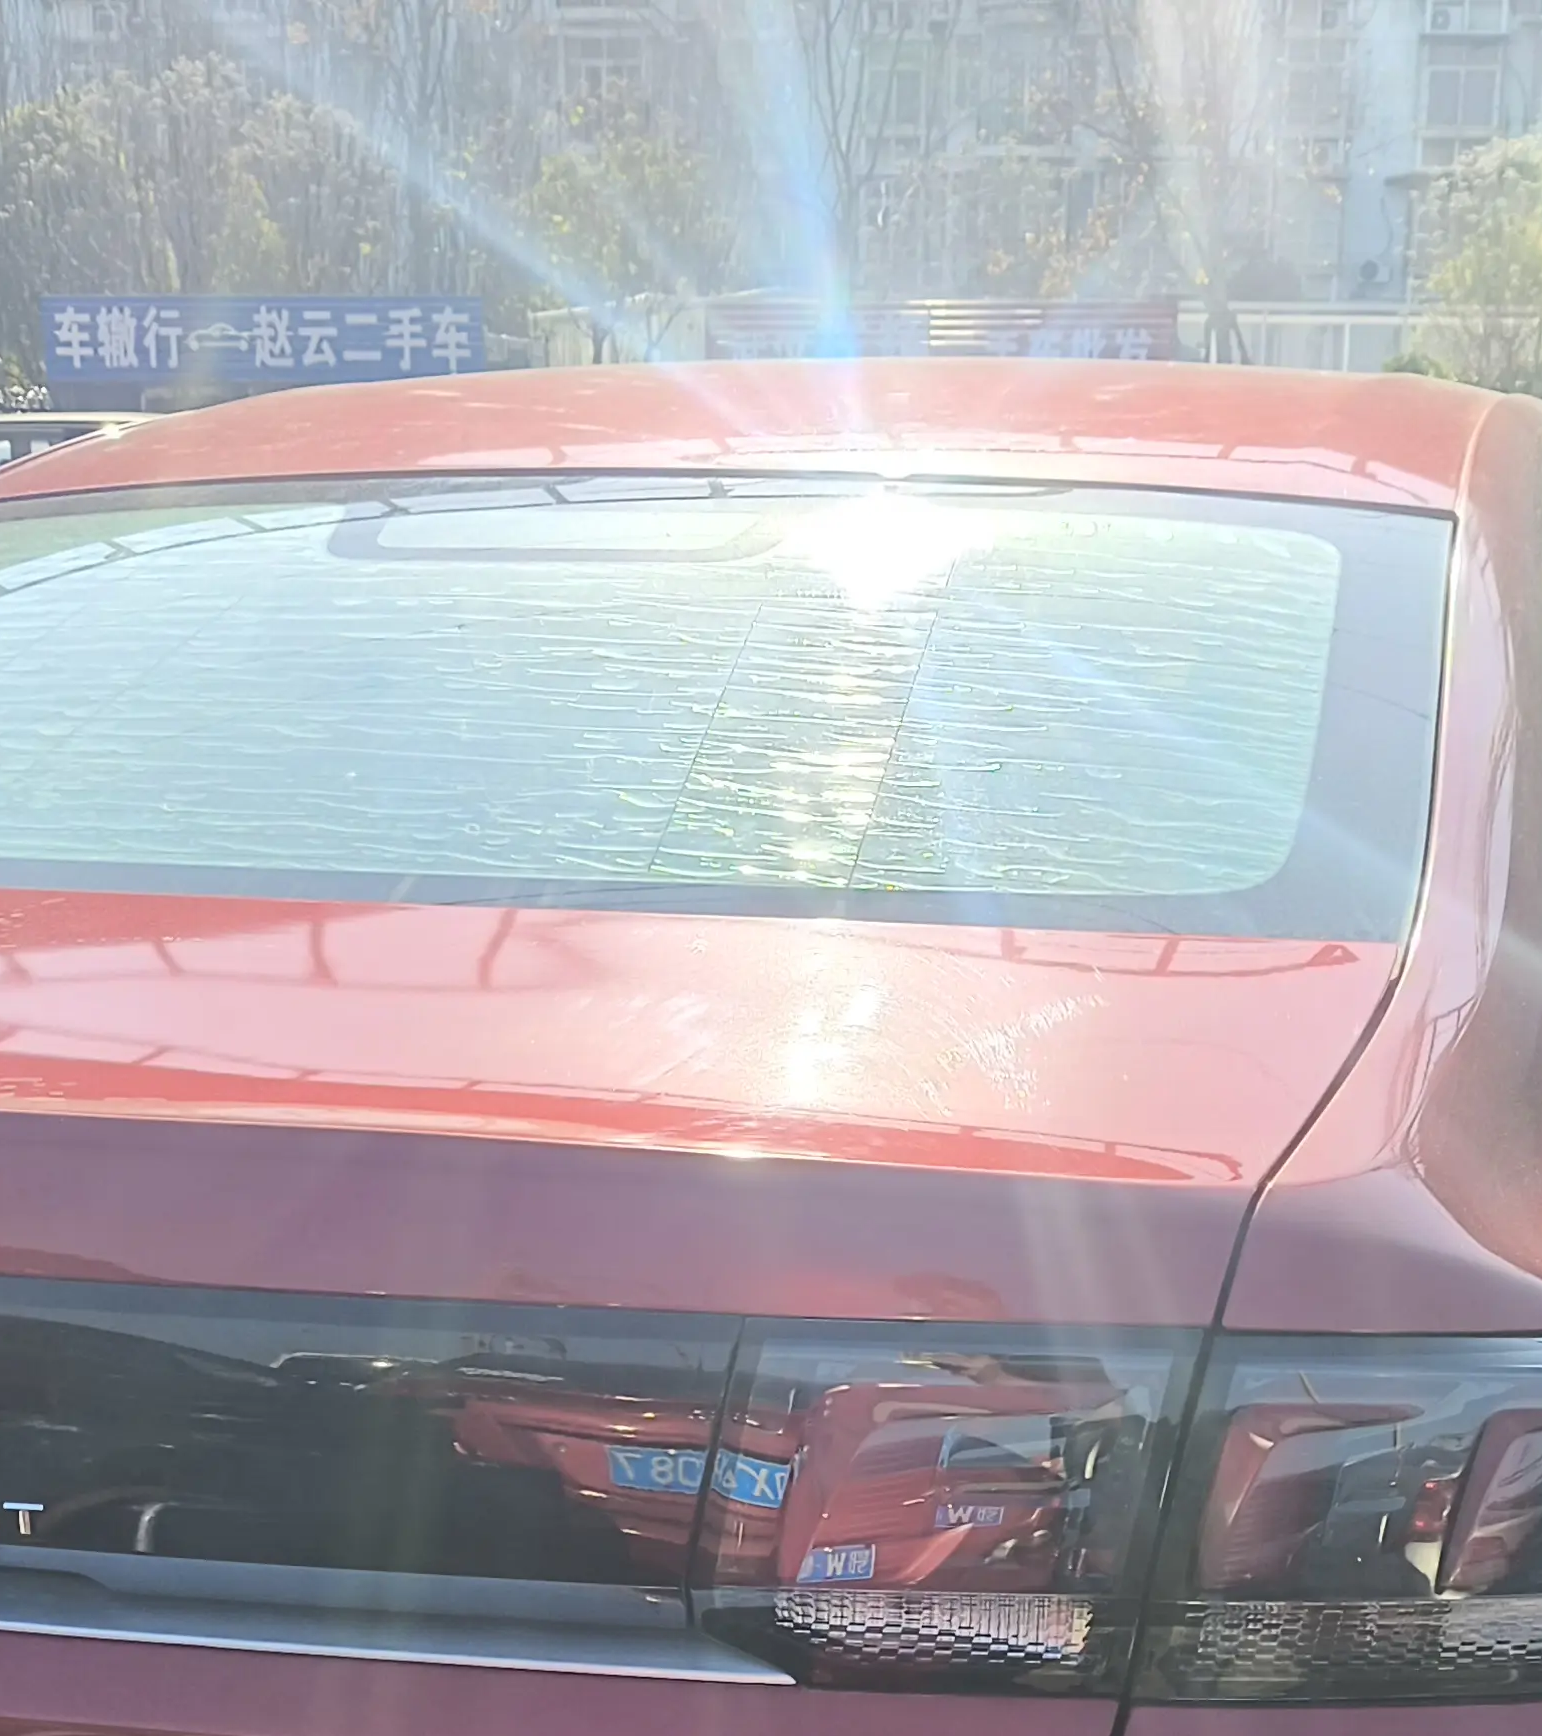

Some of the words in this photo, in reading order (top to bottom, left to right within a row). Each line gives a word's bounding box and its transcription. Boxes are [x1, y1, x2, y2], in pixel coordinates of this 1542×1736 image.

[252, 305, 473, 374] 赵云二手车
